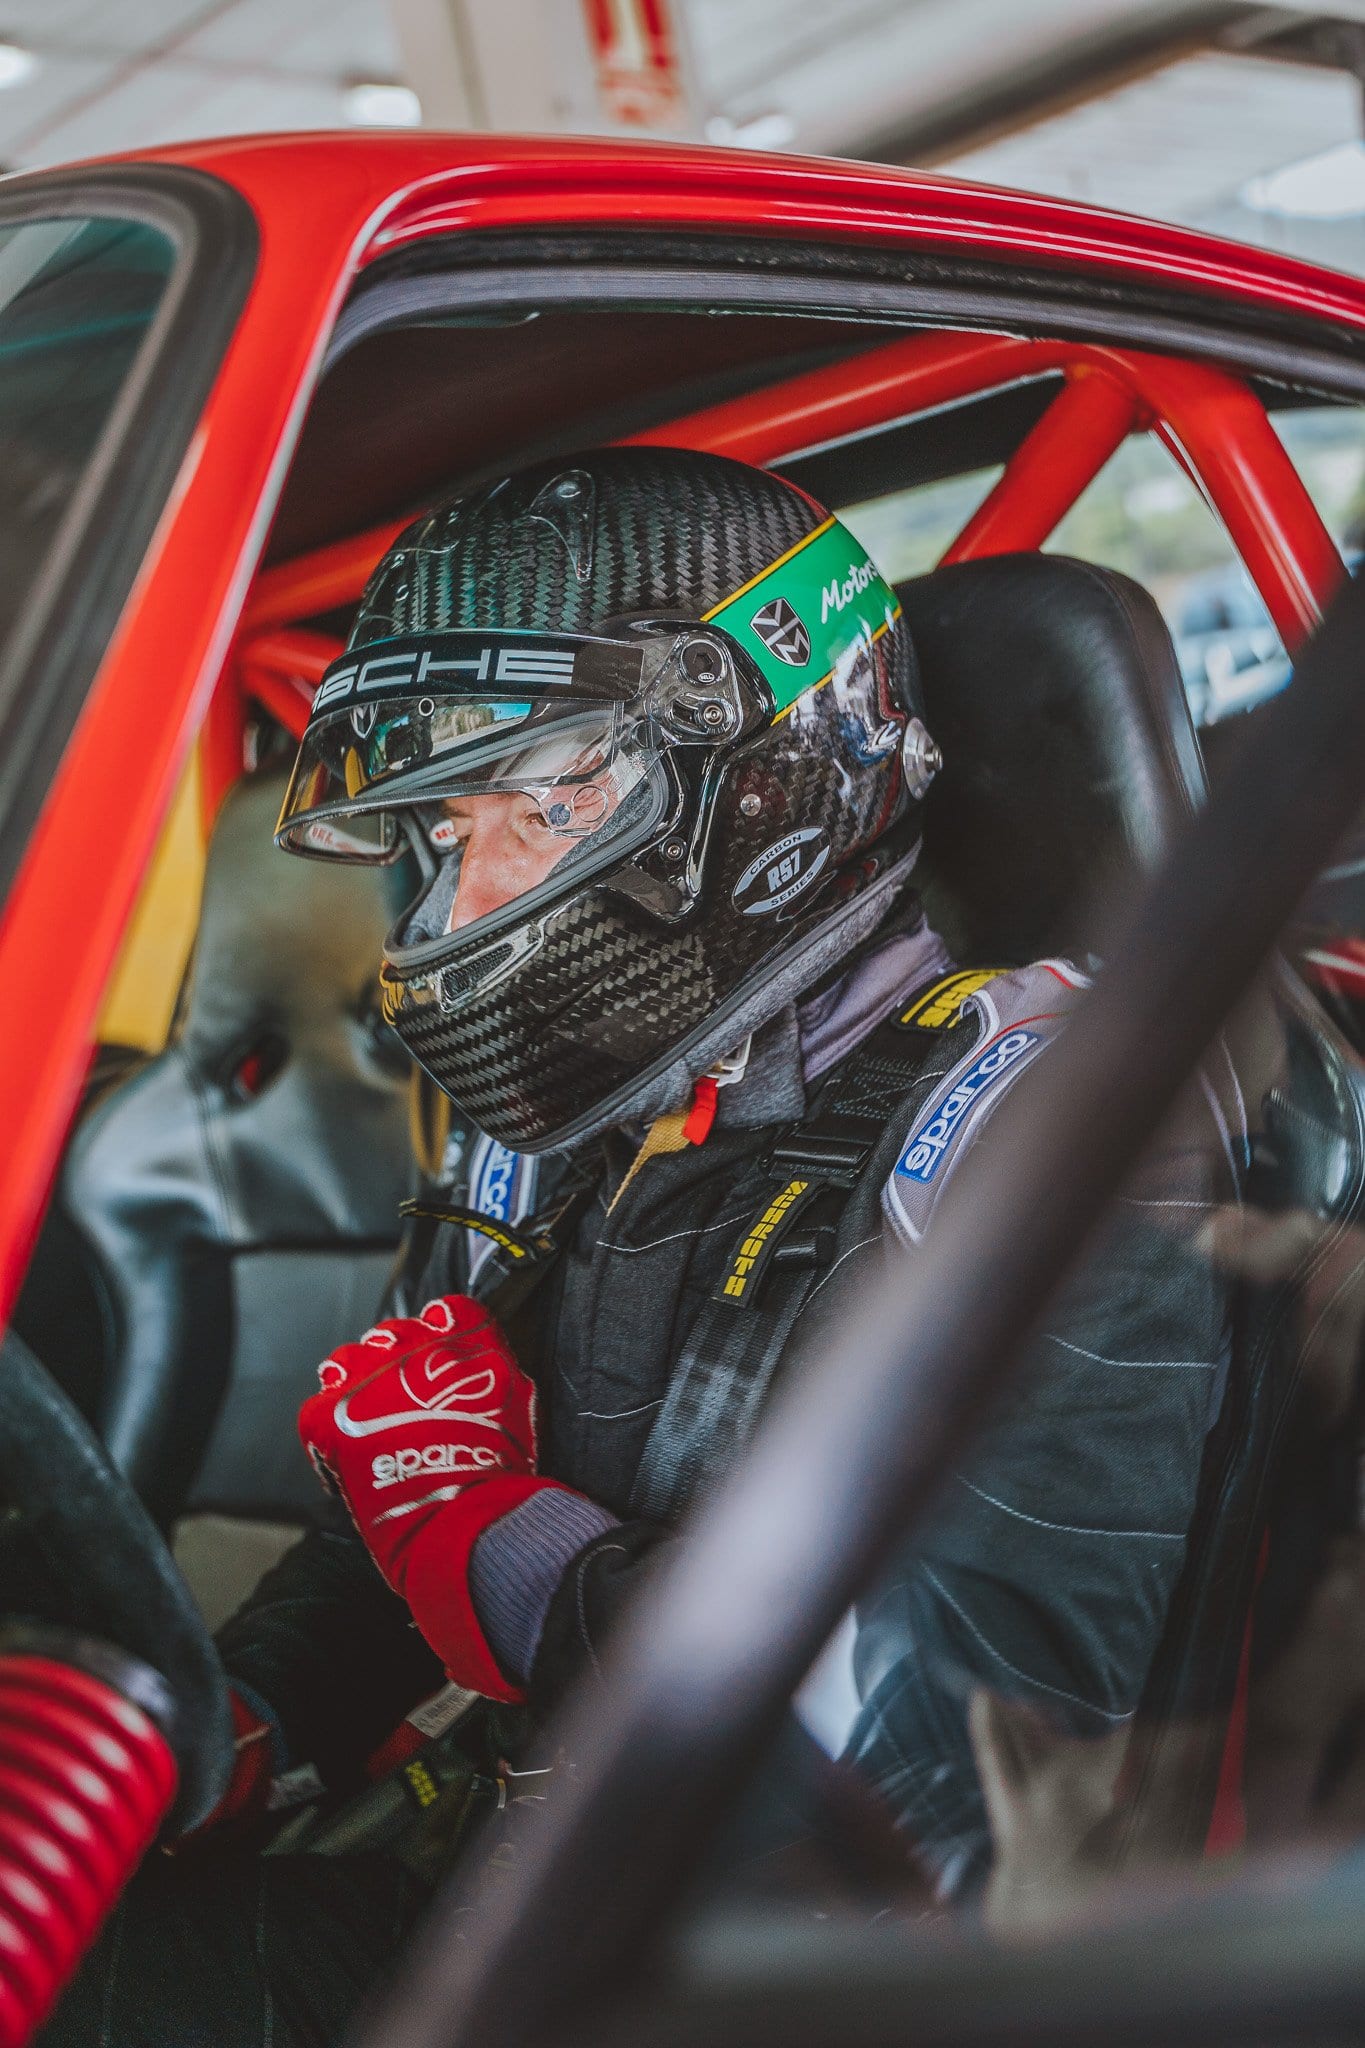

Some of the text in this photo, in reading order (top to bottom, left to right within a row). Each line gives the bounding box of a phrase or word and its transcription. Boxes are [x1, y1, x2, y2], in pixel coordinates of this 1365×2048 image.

[750, 834, 802, 875] CARBON
[767, 848, 800, 893] RS7
[770, 871, 814, 906] SERIES
[905, 1033, 1037, 1178] sparco
